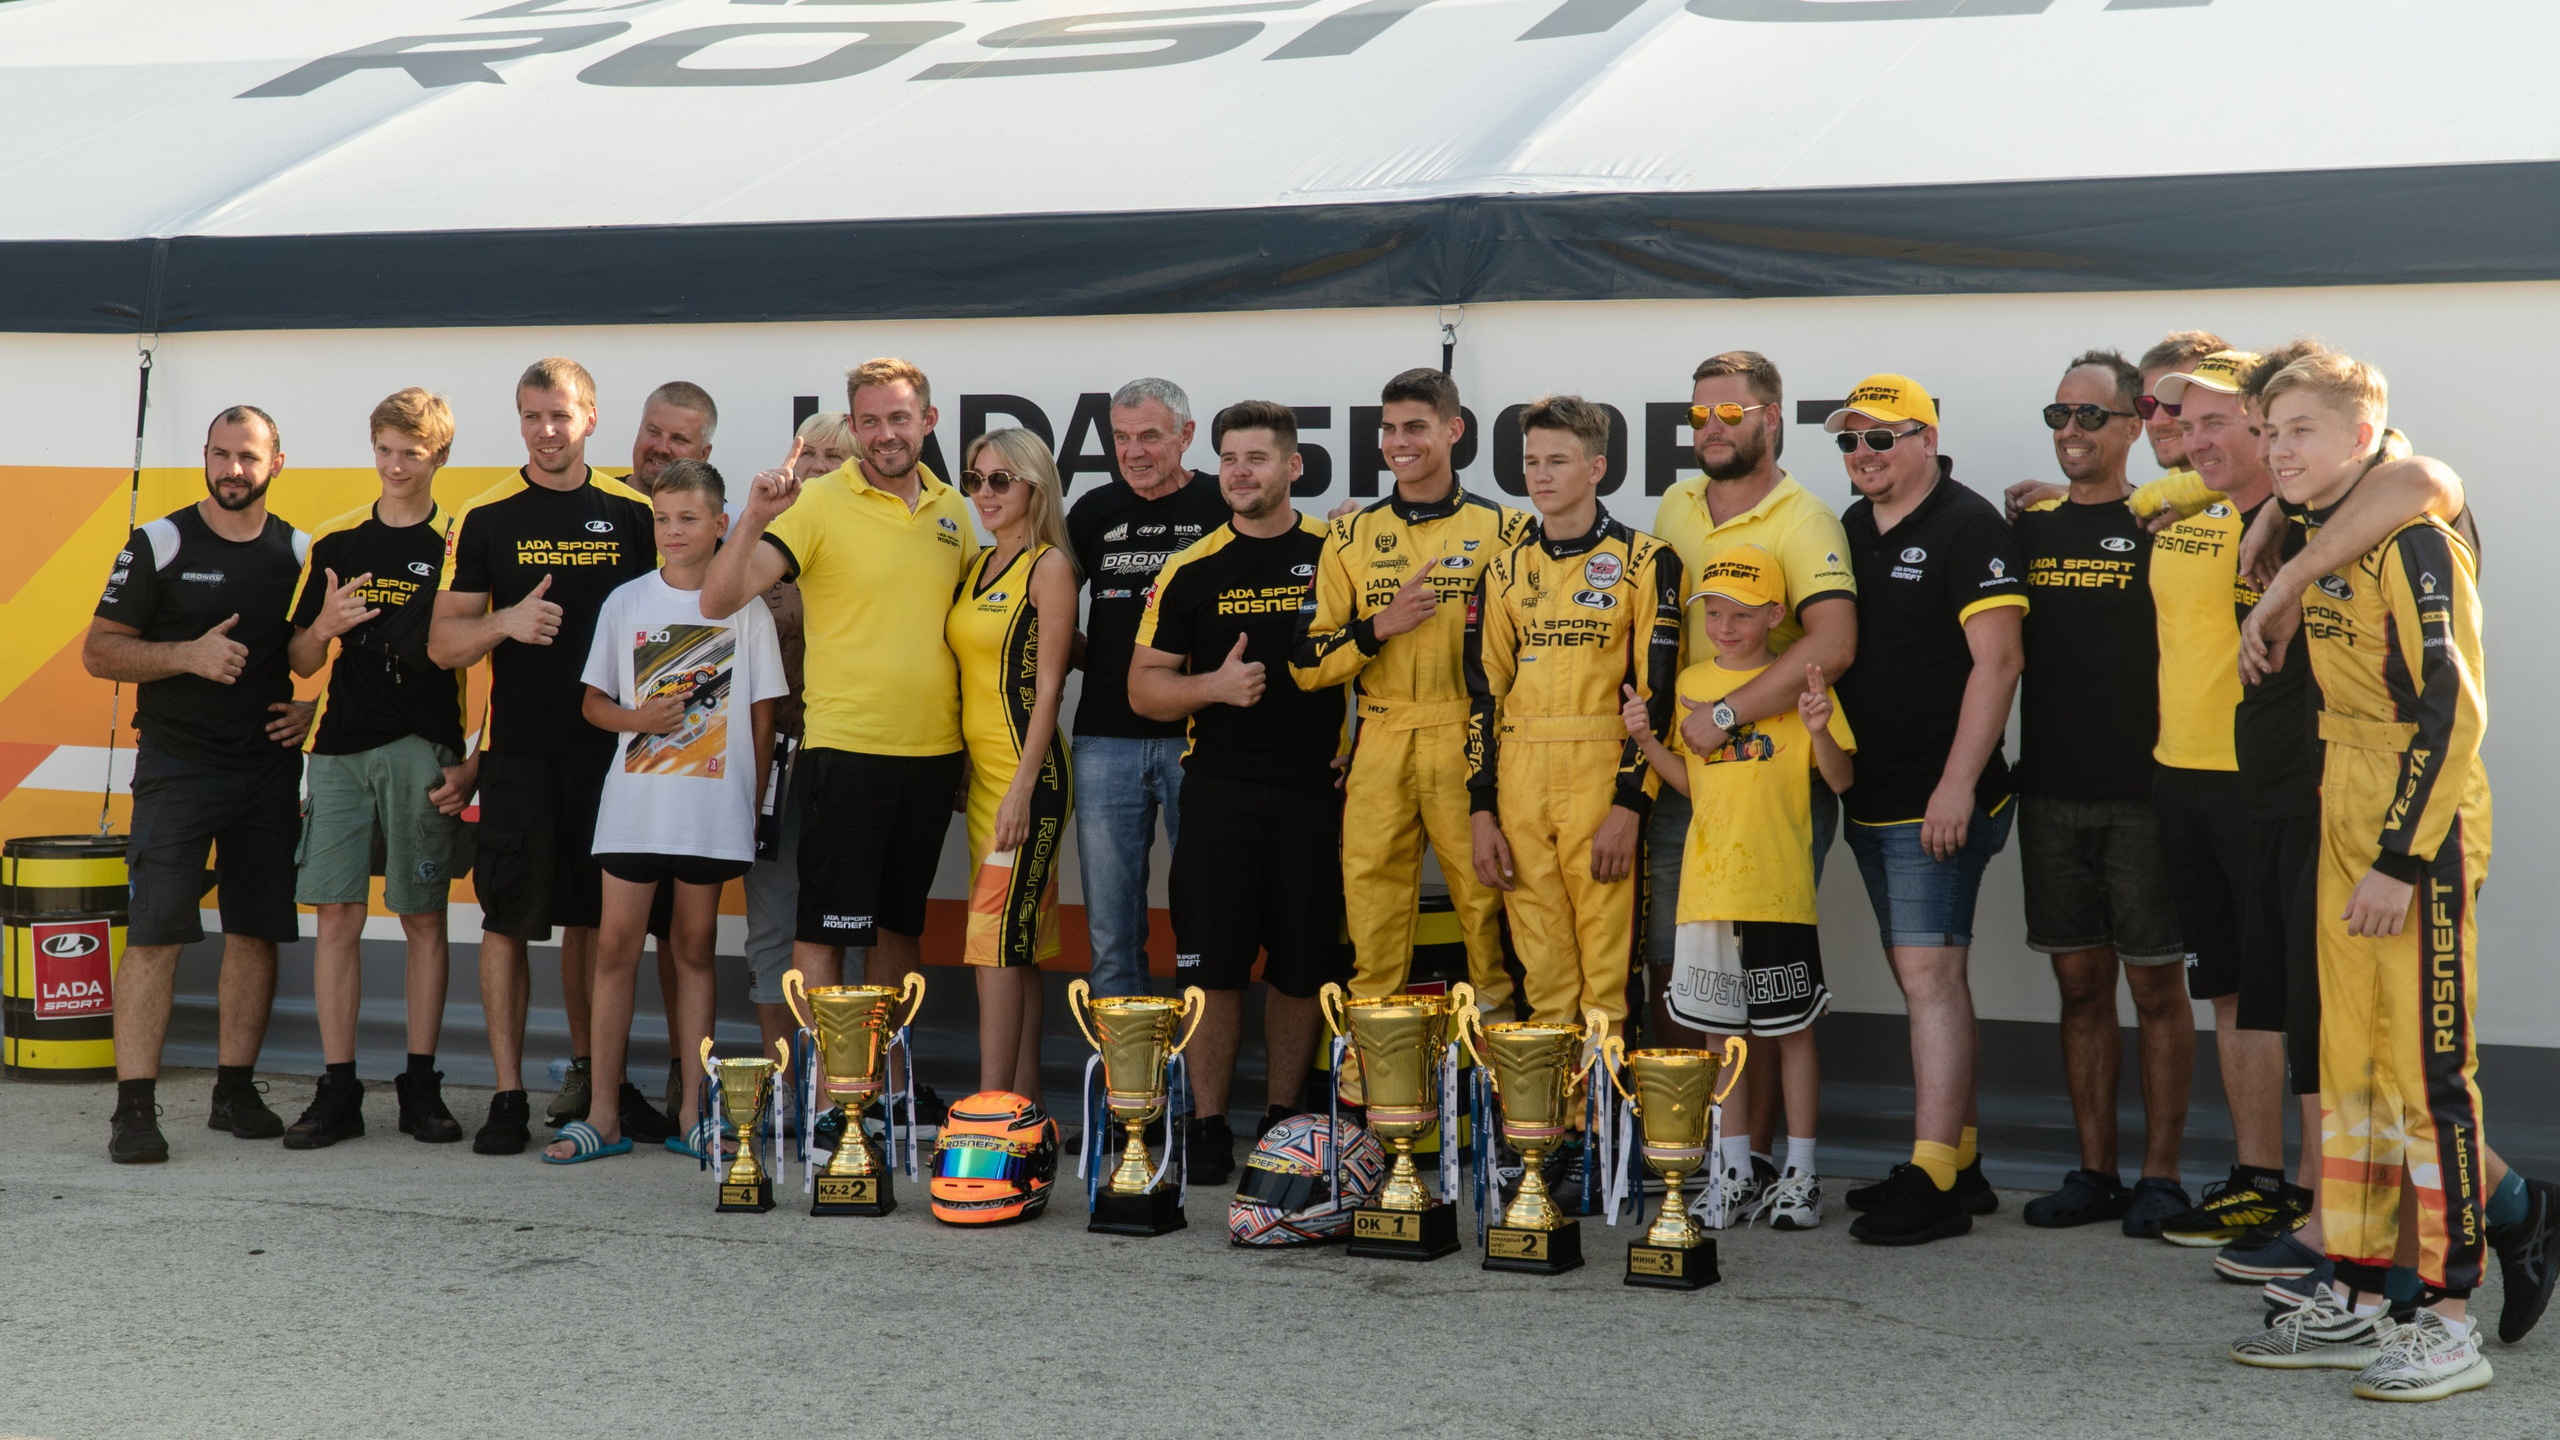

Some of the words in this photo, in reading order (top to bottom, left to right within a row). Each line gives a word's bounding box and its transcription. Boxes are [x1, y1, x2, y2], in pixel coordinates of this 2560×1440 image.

[233, 0, 2200, 99] ROSN
[2198, 363, 2240, 376] NEFT
[1335, 516, 1350, 541] HRX
[1503, 511, 1526, 539] HRX
[2175, 525, 2228, 540] SPORT
[517, 540, 552, 551] LADA
[557, 541, 619, 551] SPORT
[2154, 535, 2225, 558] ROSNEFT
[518, 552, 621, 566] ROSNEFT
[1101, 552, 1172, 570] DRON
[1628, 541, 1653, 577] HRX
[1718, 561, 1761, 573] SPORT
[2029, 557, 2057, 570] LADA
[2063, 559, 2136, 573] SPORT
[1494, 555, 1508, 582] HRX
[1702, 568, 1760, 583] ROSNEFT
[1890, 571, 1923, 582] ROSNEFT
[376, 578, 420, 592] SPOR
[1366, 578, 1401, 591] LADA
[1419, 577, 1476, 588] PORT
[2027, 571, 2133, 590] ROSNEFT
[350, 589, 412, 606] OSNE
[1218, 588, 1256, 600] LADA
[1261, 586, 1309, 598] SPOR
[1365, 589, 1476, 608] ROFT
[1218, 597, 1305, 615] ROSNE
[1544, 619, 1613, 632] SPORT
[2302, 606, 2353, 628] PORT
[649, 630, 671, 643] 50
[1526, 631, 1611, 649] SNEFT
[2304, 622, 2358, 648] NEFT
[1020, 617, 1039, 679] LADA
[1368, 704, 1389, 714] HRX
[1019, 686, 1058, 792] SPRT
[1468, 712, 1485, 775] VESTA
[2385, 748, 2431, 832] VESTA
[1013, 817, 1058, 959] ROSNEFT
[823, 920, 873, 929] ROSNEFT
[2431, 877, 2457, 1053] ROSNEFT
[43, 980, 104, 999] LADA
[44, 998, 105, 1011] SPORT
[946, 1139, 1002, 1151] ROSNEFT
[1248, 1157, 1283, 1171] SNEFT
[2454, 1123, 2472, 1200] SPORT
[740, 1188, 752, 1203] 4
[820, 1184, 849, 1195] KZ-2
[851, 1179, 867, 1197] 2
[1357, 1217, 1381, 1231] OK
[1393, 1216, 1404, 1233] 1
[2465, 1202, 2476, 1247] LADA
[1521, 1234, 1538, 1253] 2
[1632, 1256, 1656, 1265] МИНИ
[1659, 1252, 1674, 1274] 3
